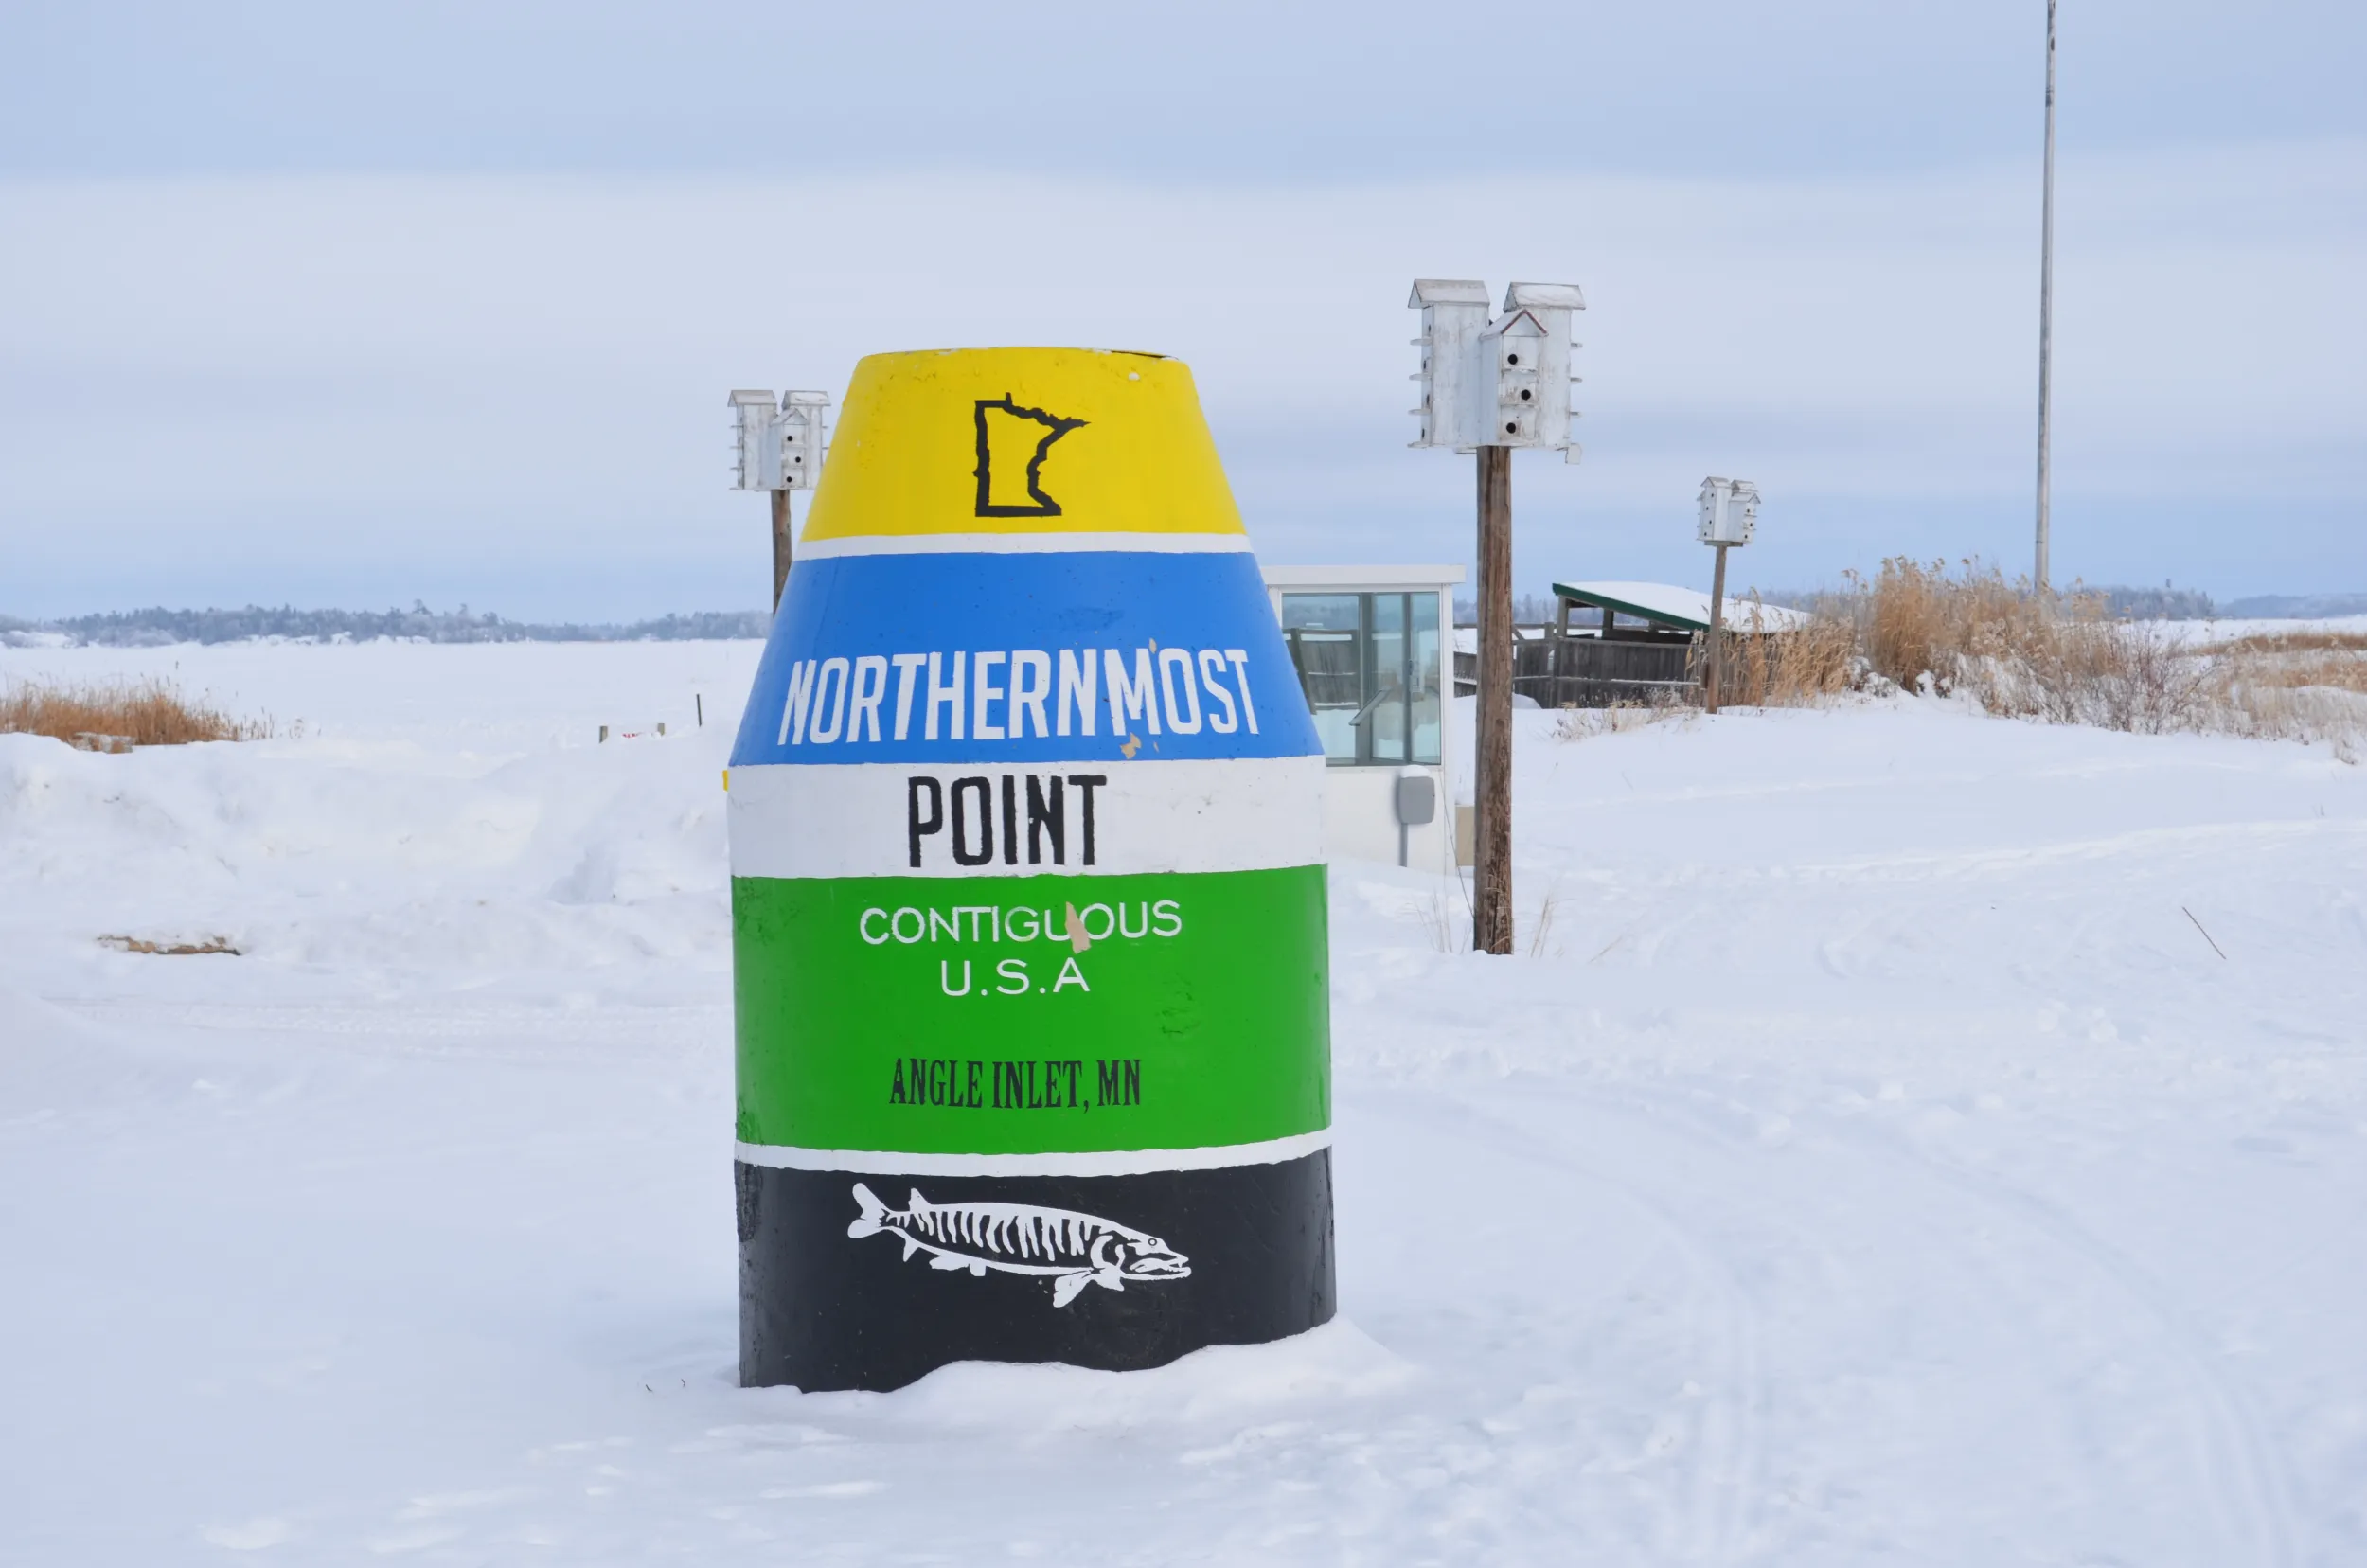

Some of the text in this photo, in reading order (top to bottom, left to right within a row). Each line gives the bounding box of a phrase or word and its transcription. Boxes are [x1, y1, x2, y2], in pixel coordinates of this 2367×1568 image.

[777, 648, 1259, 745] NORTHERNMOST
[908, 774, 1107, 868] POINT
[859, 900, 1183, 945] CONTIGUOUS
[940, 957, 1090, 997] U.S.A
[889, 1058, 1141, 1114] ANGLE INLET, MN
